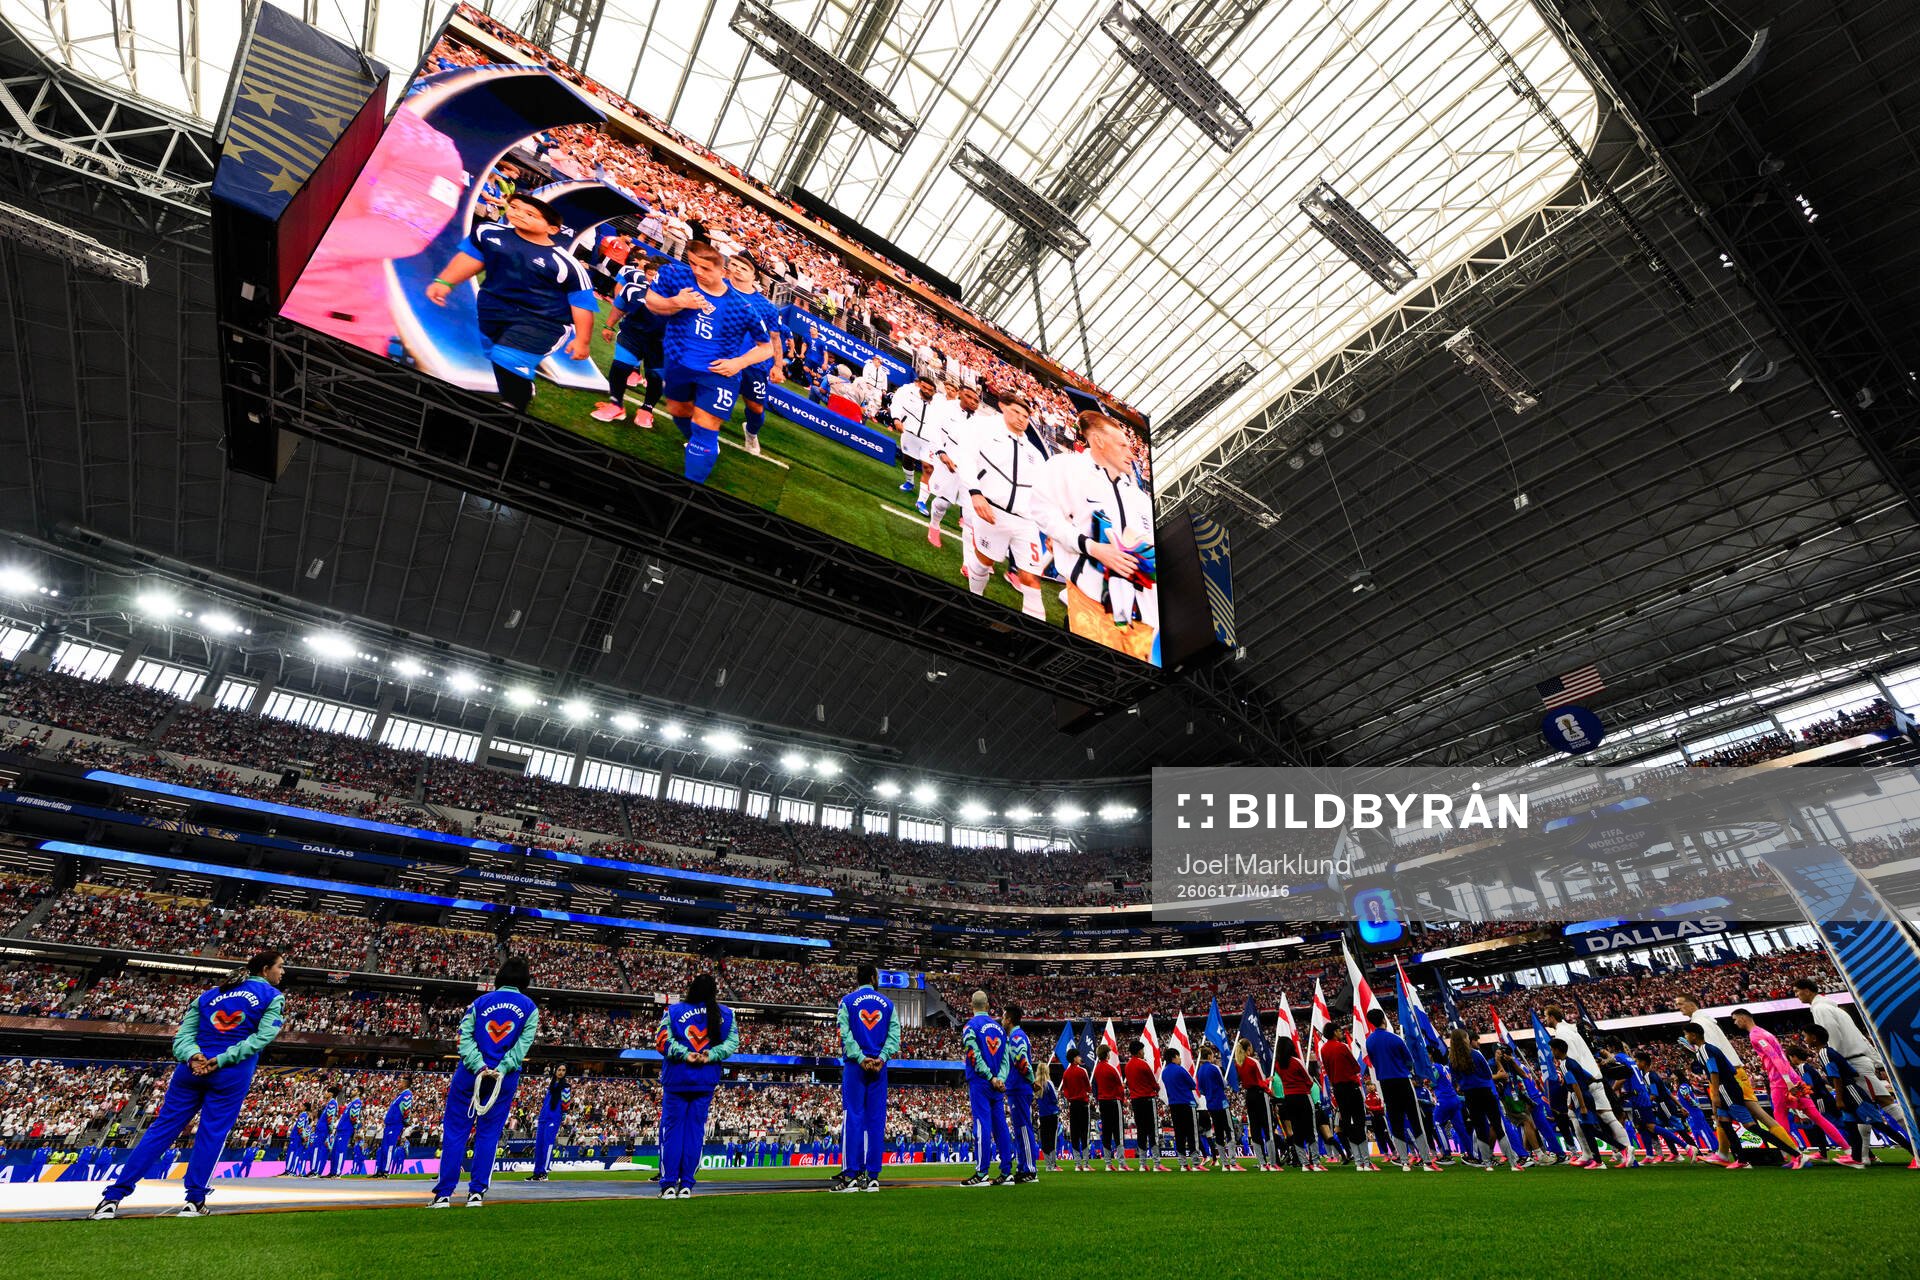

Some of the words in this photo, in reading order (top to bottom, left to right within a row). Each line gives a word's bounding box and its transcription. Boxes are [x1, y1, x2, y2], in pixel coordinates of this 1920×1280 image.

[695, 319, 713, 340] 15
[796, 312, 818, 329] FIFA
[819, 324, 854, 347] WORLD
[854, 343, 874, 357] CUP
[875, 353, 906, 374] 2026
[753, 381, 766, 395] 22
[716, 387, 733, 408] 15
[768, 394, 790, 411] FIFA
[791, 405, 829, 428] WORLD
[829, 423, 850, 437] CUP
[850, 433, 884, 454] 2026
[16, 796, 72, 811] #FIFAWorldCup
[1588, 836, 1625, 850] WORLD
[1625, 831, 1646, 842] CUP
[1601, 828, 1624, 839] FIFA
[302, 845, 354, 858] DALLAS
[1602, 841, 1639, 855] 2026
[495, 874, 520, 882] WORLD
[534, 878, 557, 887] 2026
[659, 895, 696, 905] DALLAS
[1586, 915, 1727, 952] DALLAS
[209, 990, 260, 1007] VOLUNTEER
[854, 994, 888, 1008] VOLUNTEER
[481, 1002, 524, 1019] VOLUNTEER
